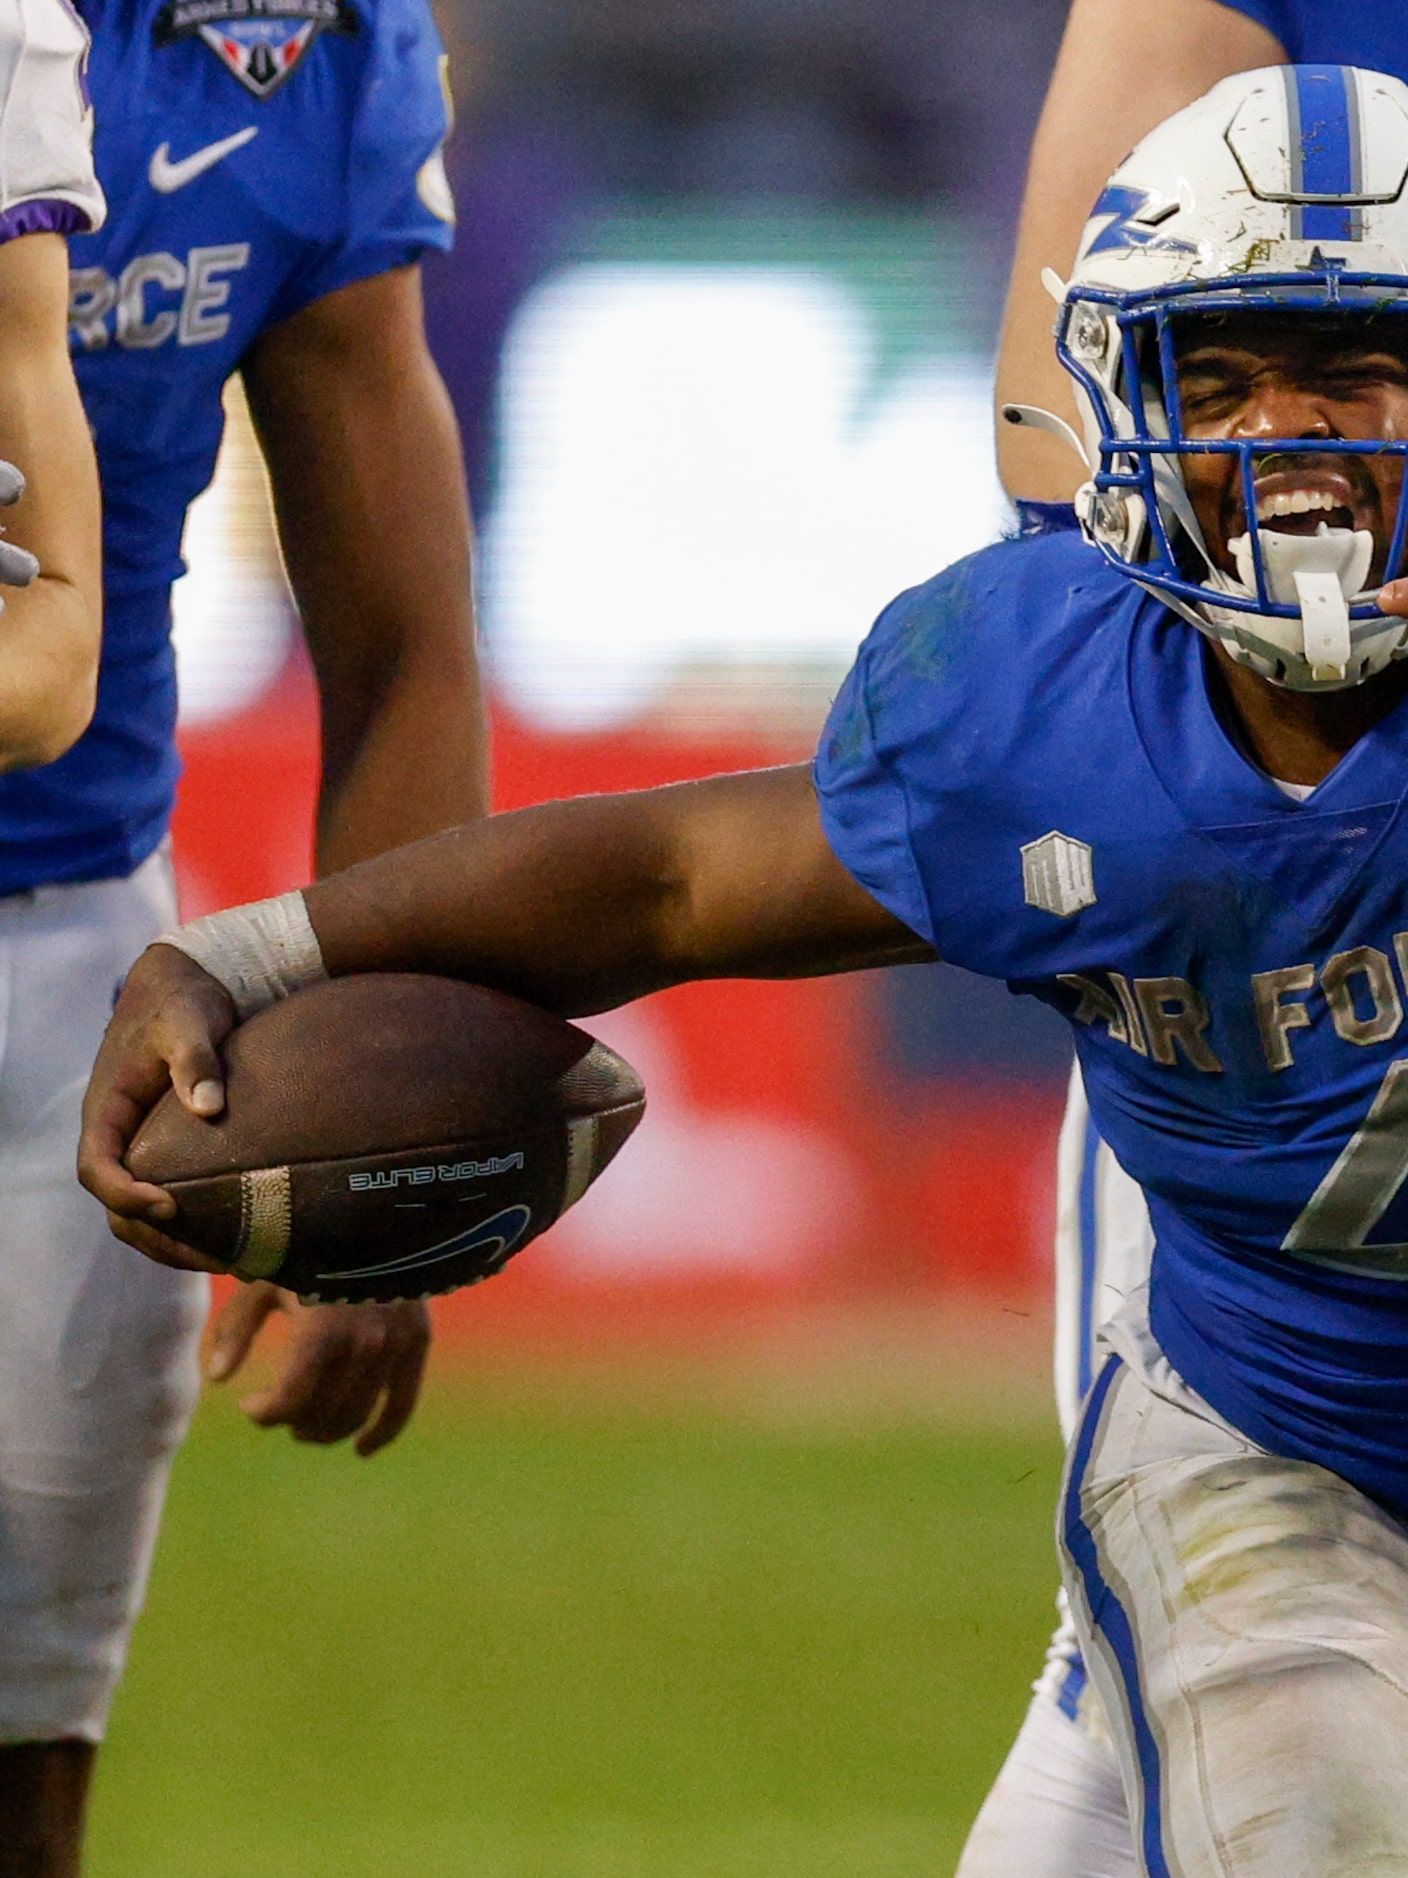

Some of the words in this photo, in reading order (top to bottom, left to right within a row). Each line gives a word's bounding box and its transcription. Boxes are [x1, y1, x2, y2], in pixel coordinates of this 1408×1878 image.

[1056, 971, 1224, 1072] AIR
[348, 1166, 436, 1192] ELITE
[437, 1152, 525, 1182] VAPOR
